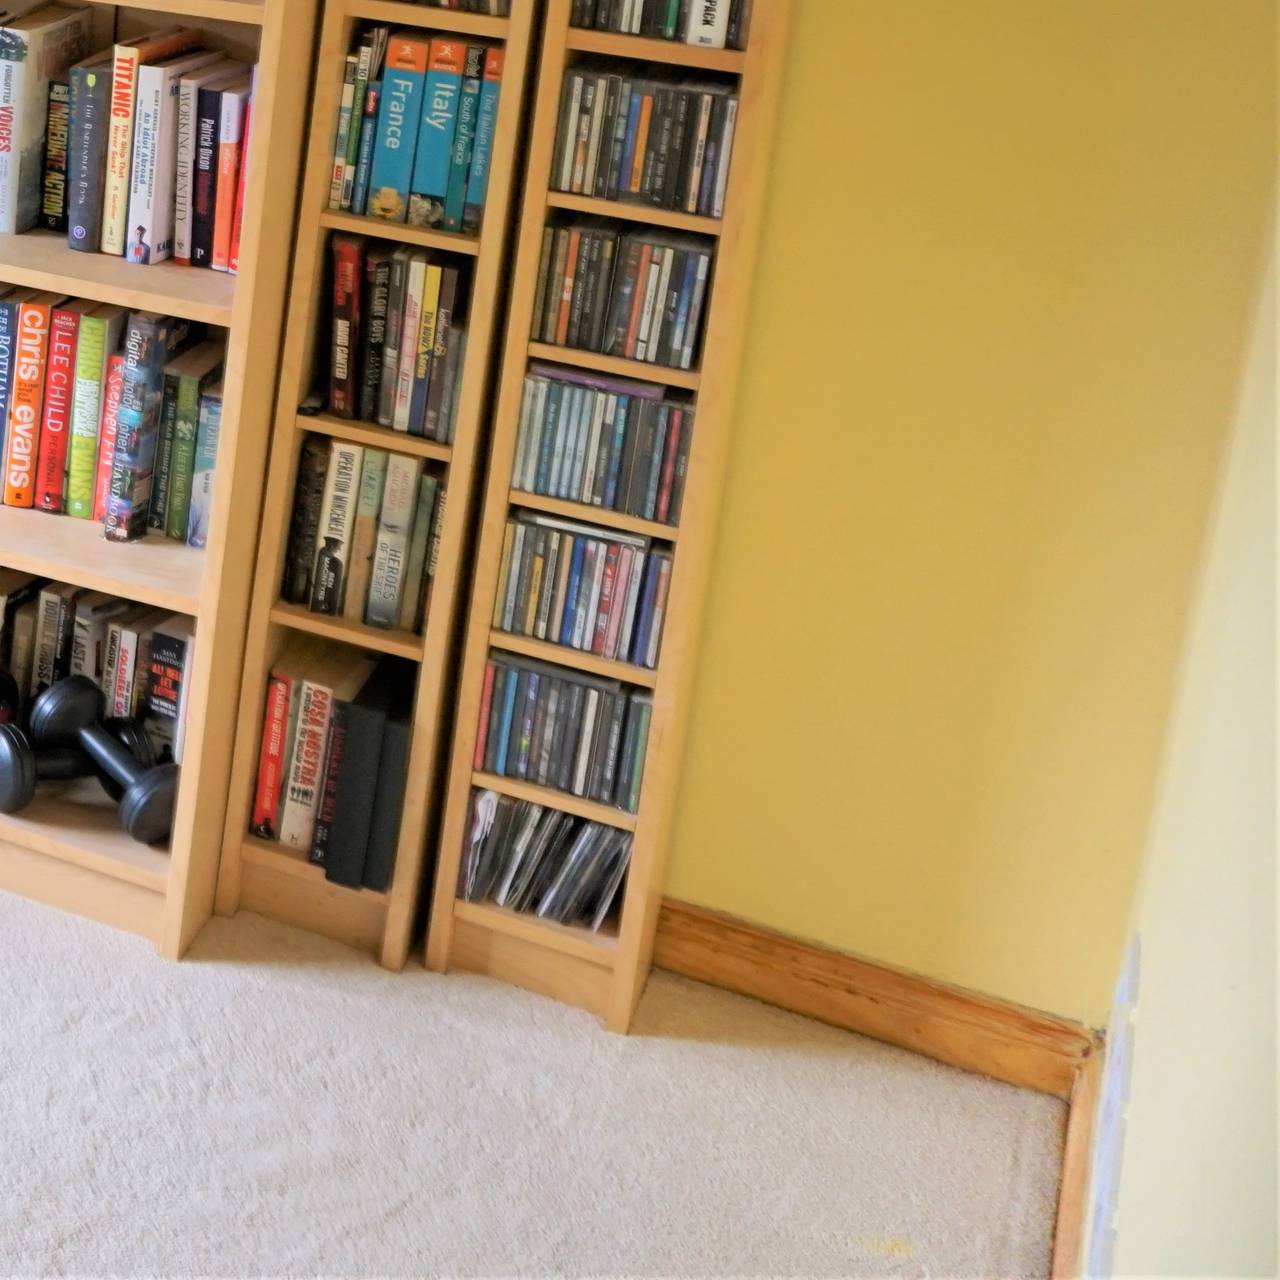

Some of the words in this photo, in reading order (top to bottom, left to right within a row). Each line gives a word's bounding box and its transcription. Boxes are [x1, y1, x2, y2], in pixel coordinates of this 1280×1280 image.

[701, 0, 718, 26] PACK
[112, 57, 134, 119] TITANIC
[426, 82, 457, 131] Italy
[144, 112, 151, 123] An
[386, 79, 413, 149] France
[141, 127, 150, 148] Idiot
[139, 150, 149, 185] Abroad
[19, 309, 47, 381] chris
[54, 331, 72, 369] LEE
[124, 330, 143, 370] digital
[337, 319, 350, 345] DAVID
[335, 346, 348, 380] CANTER
[47, 372, 68, 432] CHILD
[10, 405, 36, 488] evans
[335, 451, 354, 493] OPERATION
[328, 494, 349, 538] MINCEMEAT
[309, 689, 328, 726] COSA
[300, 730, 320, 786] NOSTRA
